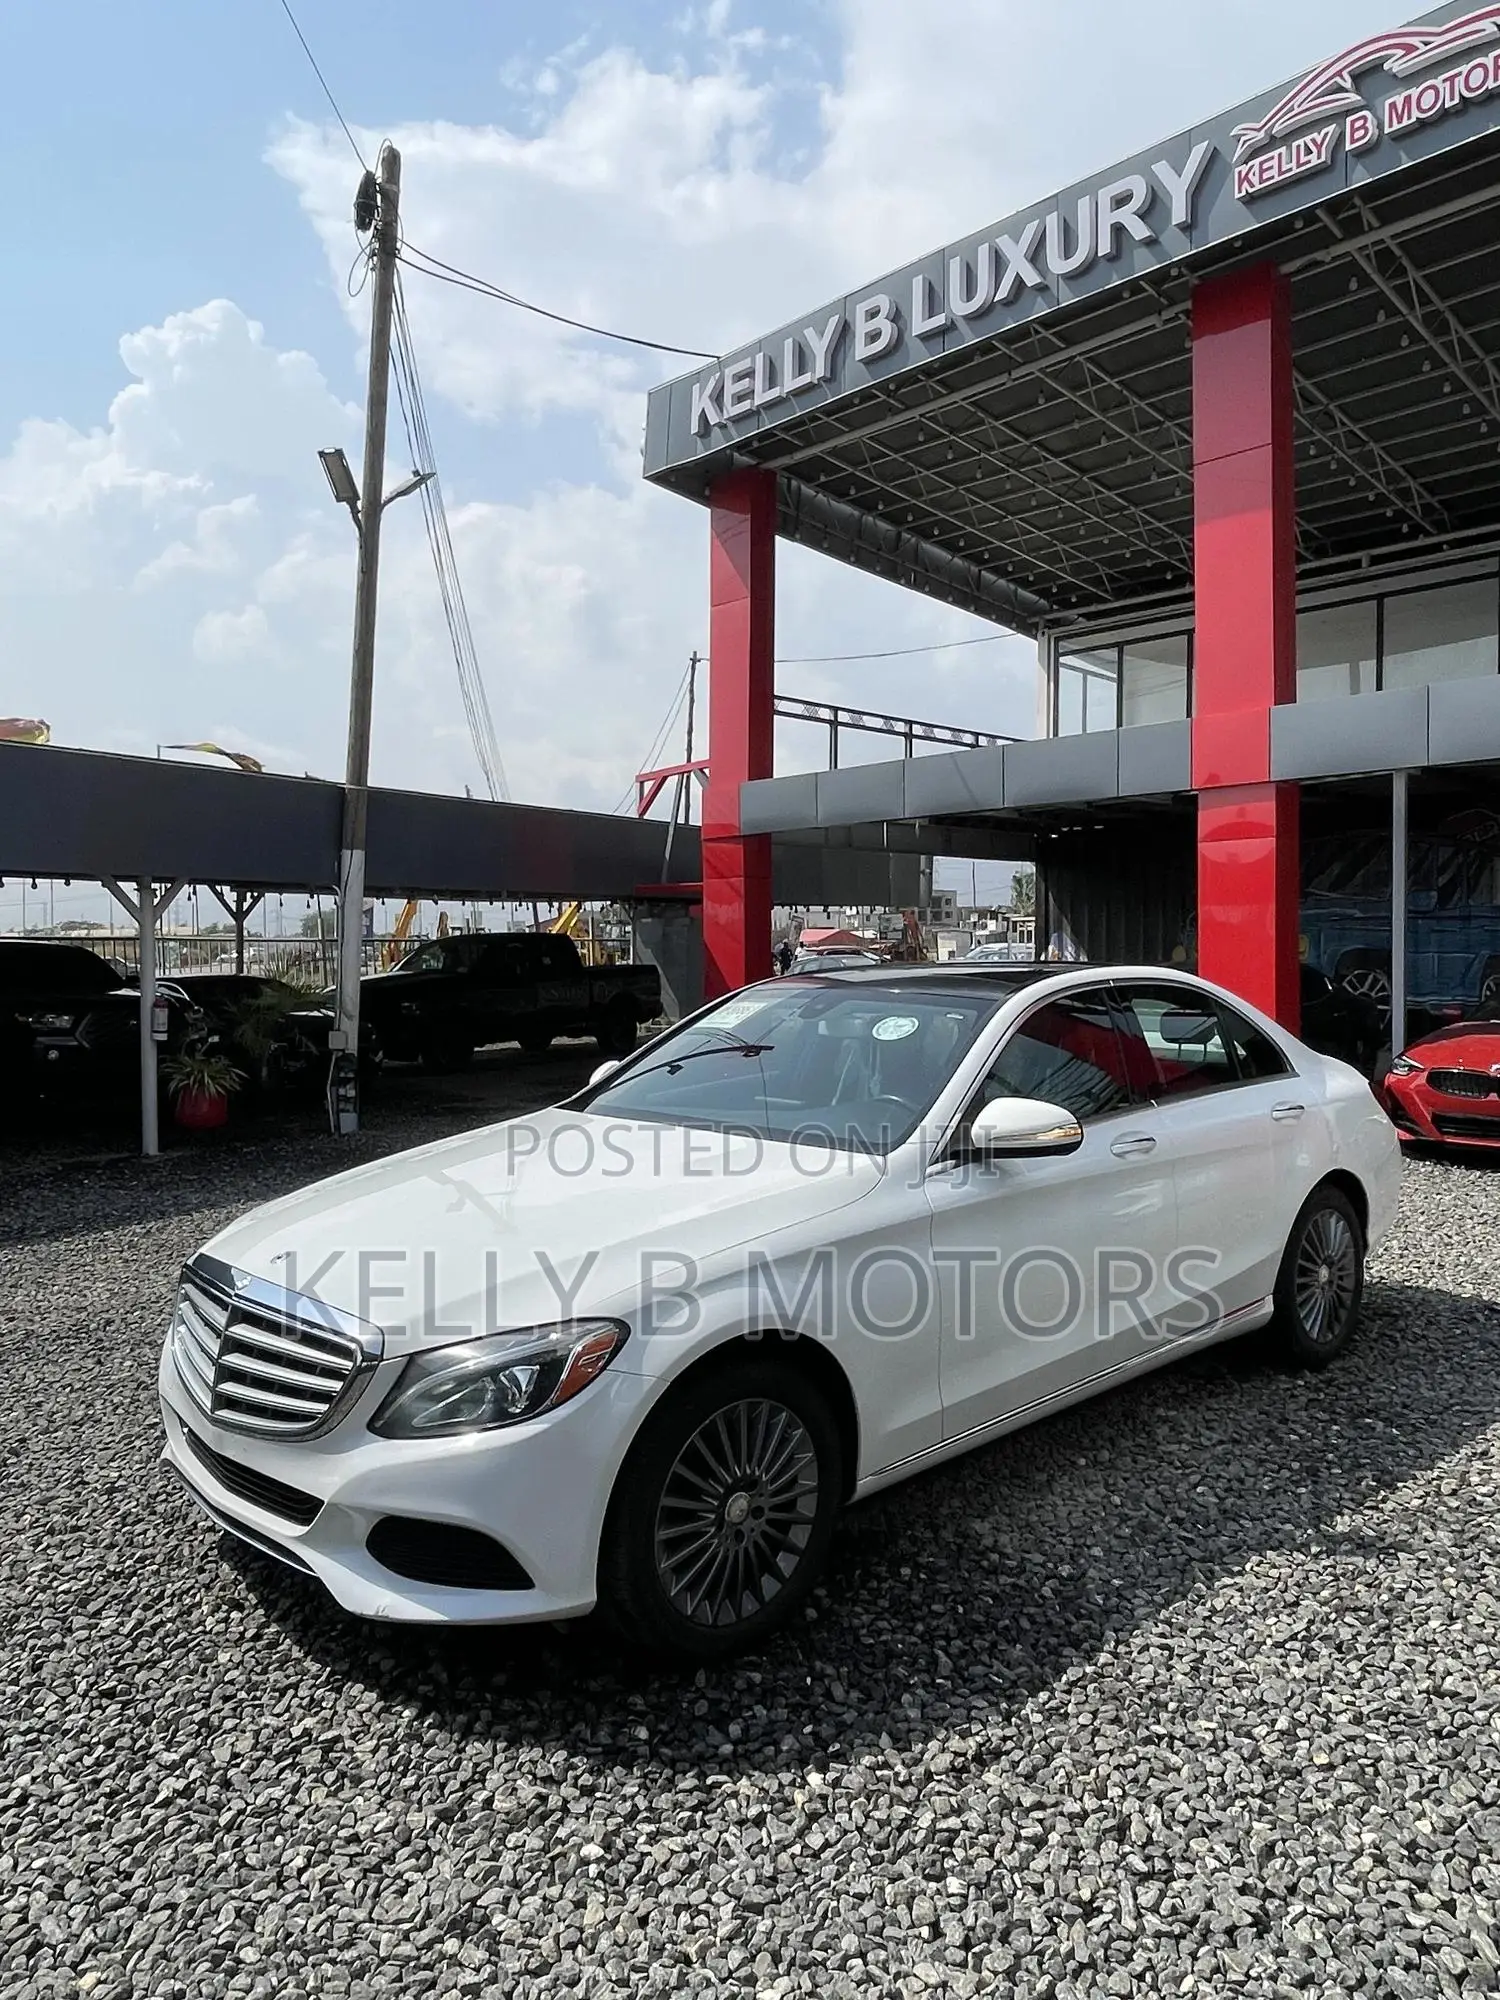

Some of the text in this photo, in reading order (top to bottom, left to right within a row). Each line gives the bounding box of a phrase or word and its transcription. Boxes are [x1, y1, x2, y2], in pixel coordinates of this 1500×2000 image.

[1235, 124, 1339, 199] KELLY
[1346, 111, 1377, 151] B
[690, 140, 1212, 436] KELLY B LUXURY
